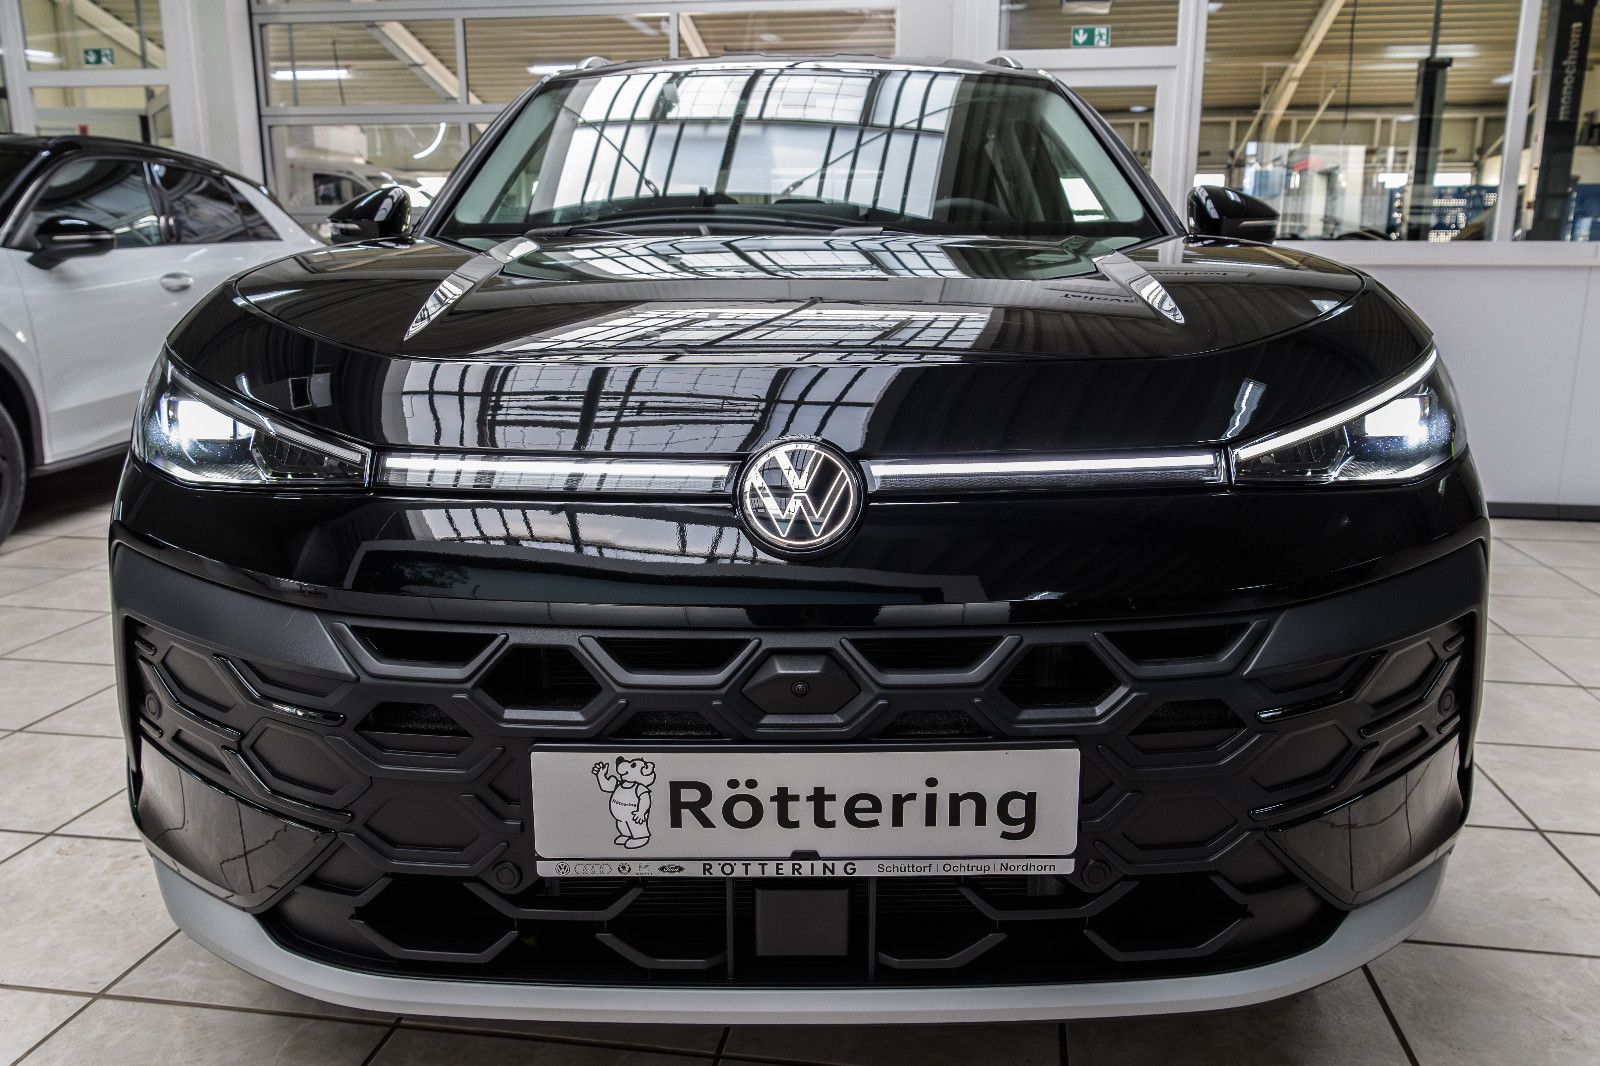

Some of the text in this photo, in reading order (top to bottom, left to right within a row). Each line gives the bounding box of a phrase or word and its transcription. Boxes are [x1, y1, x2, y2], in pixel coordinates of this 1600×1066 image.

[668, 776, 1038, 841] Röttering
[702, 861, 858, 876] RÖTTERING
[877, 862, 1056, 873] Schüttorf Ochtrup Nordhorn
